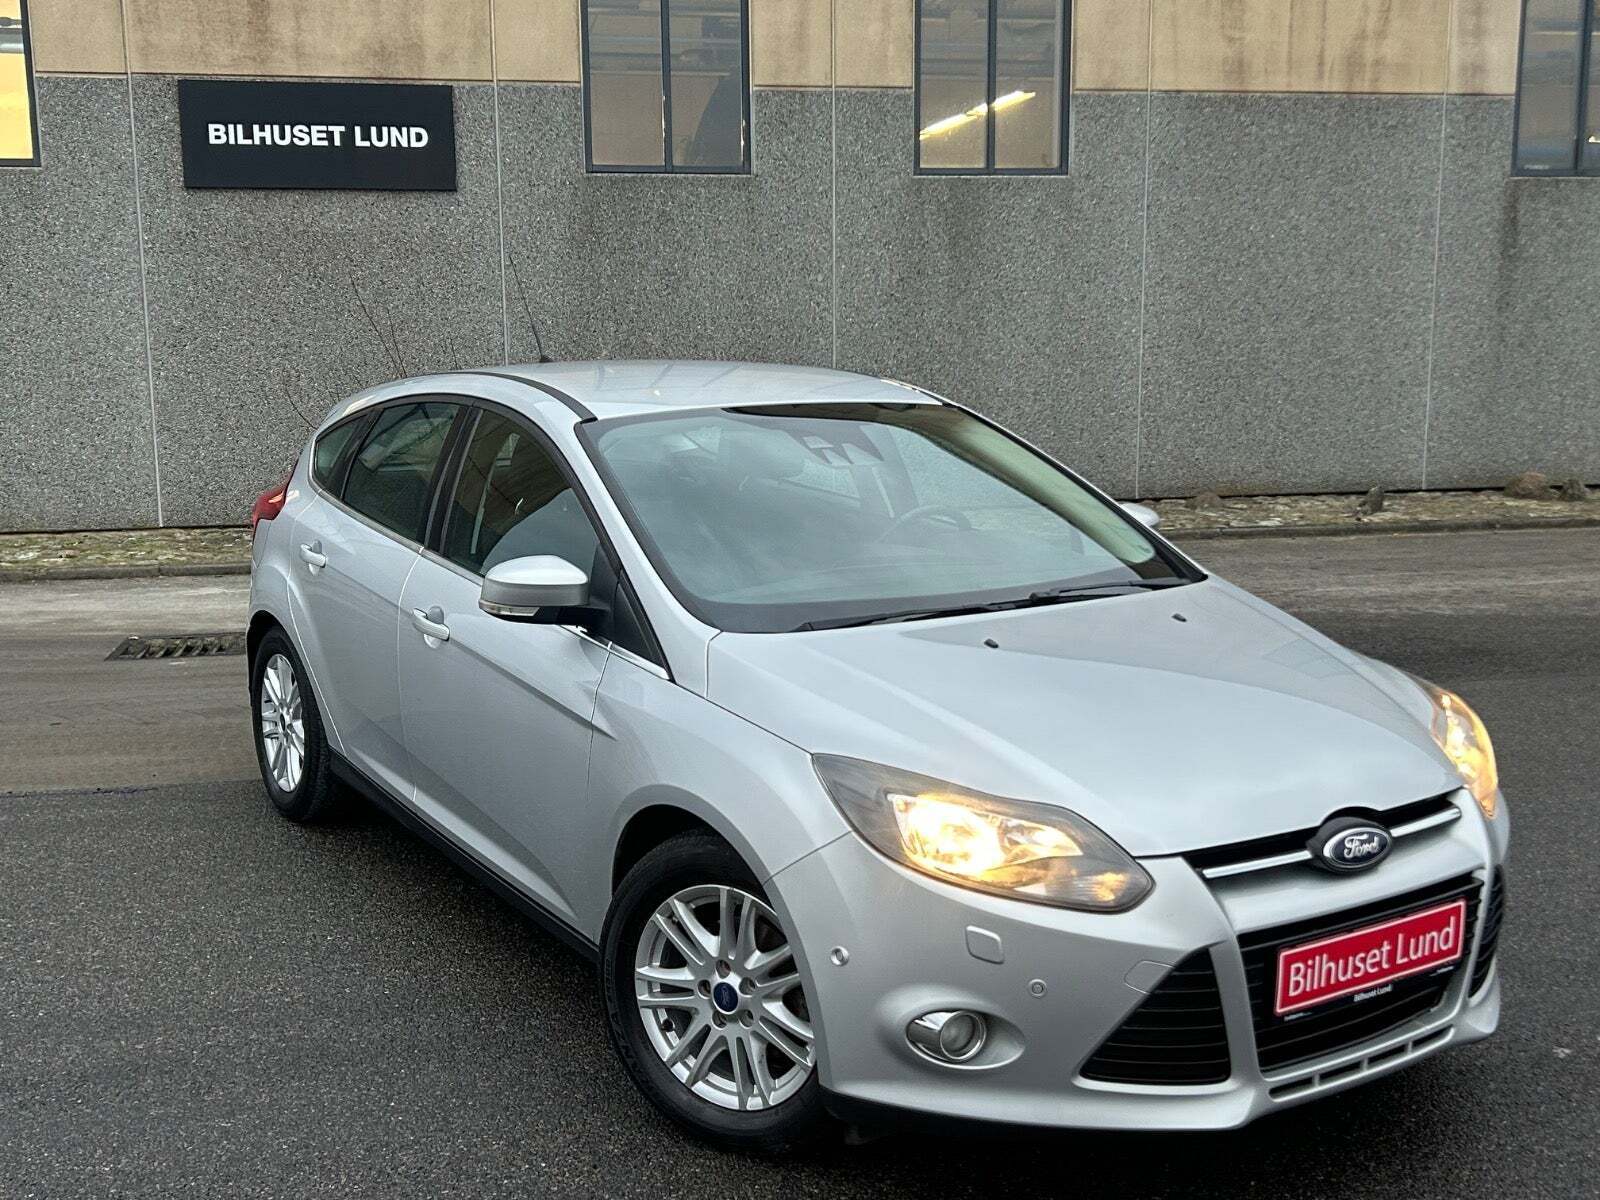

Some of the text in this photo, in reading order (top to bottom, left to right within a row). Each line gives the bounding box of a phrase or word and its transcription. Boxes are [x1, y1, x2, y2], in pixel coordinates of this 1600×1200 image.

[207, 123, 429, 148] BILHUSET LUND
[1343, 833, 1379, 859] Ford
[1288, 915, 1456, 997] Bilhuset Lund
